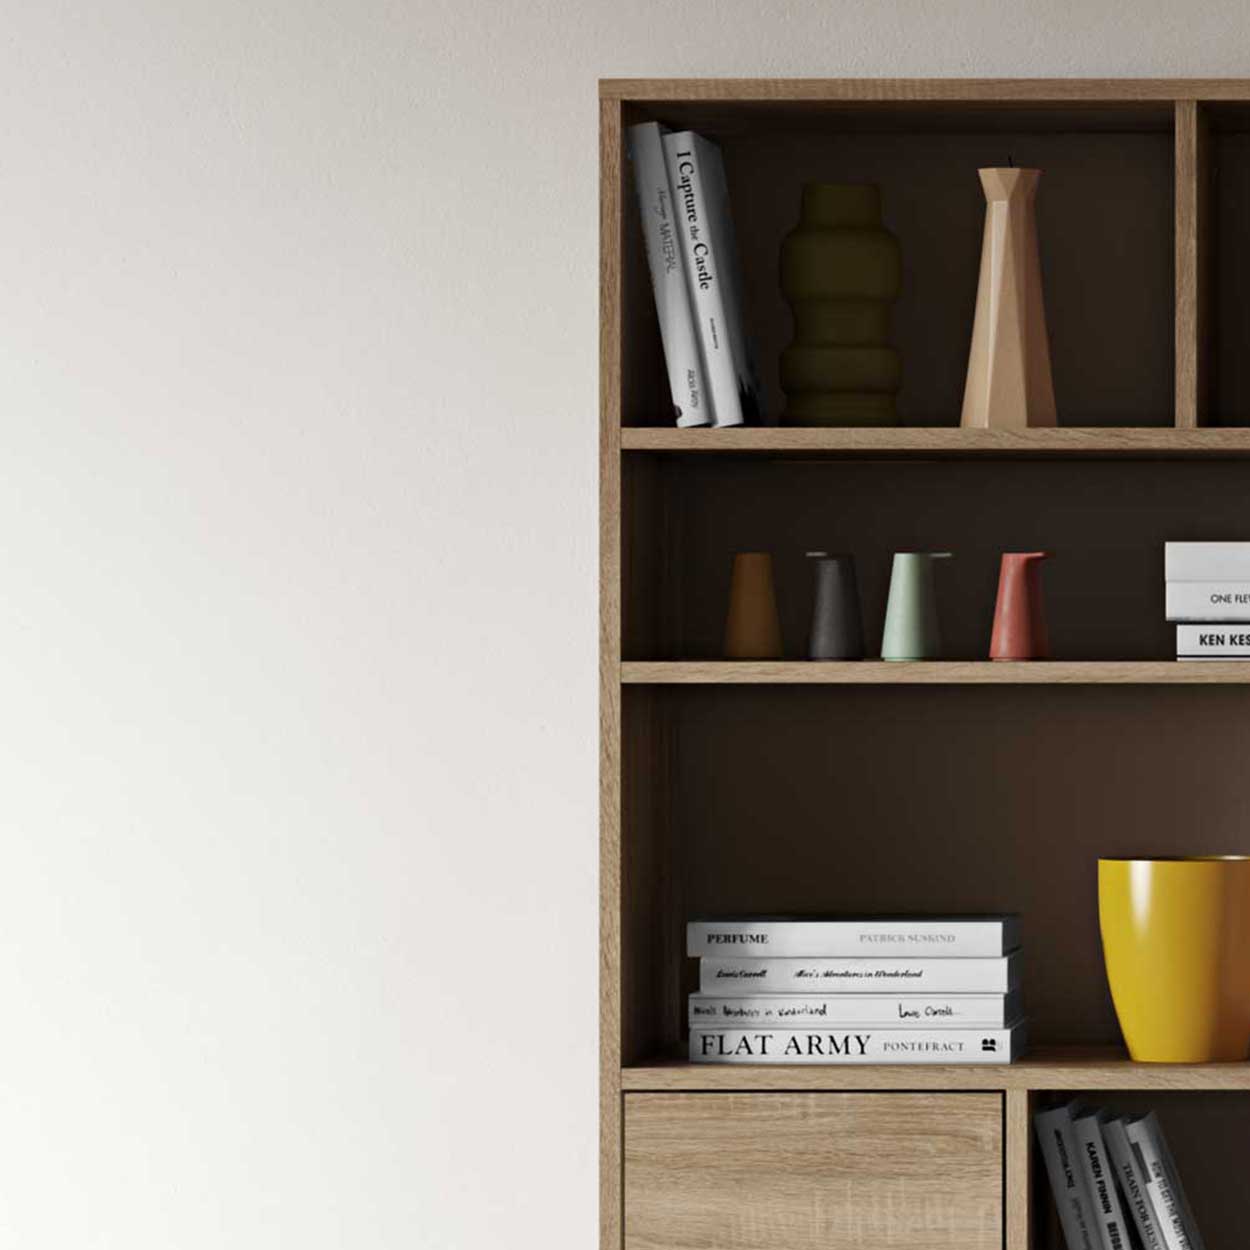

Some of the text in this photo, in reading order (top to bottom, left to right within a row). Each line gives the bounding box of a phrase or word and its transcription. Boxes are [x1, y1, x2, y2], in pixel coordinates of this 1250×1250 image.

[677, 162, 698, 222] Capture
[690, 225, 701, 240] the
[694, 243, 713, 290] Castle
[1210, 593, 1233, 604] ONE
[1199, 634, 1226, 646] KEN
[707, 934, 769, 944] PERFUME
[859, 934, 906, 943] PATRICK
[700, 1035, 965, 1055] FLAT ARMY PONTEFRACT
[1085, 1141, 1103, 1178] KAREN
[1122, 1163, 1140, 1199] TRAIN
[1136, 1199, 1150, 1222] FOR
